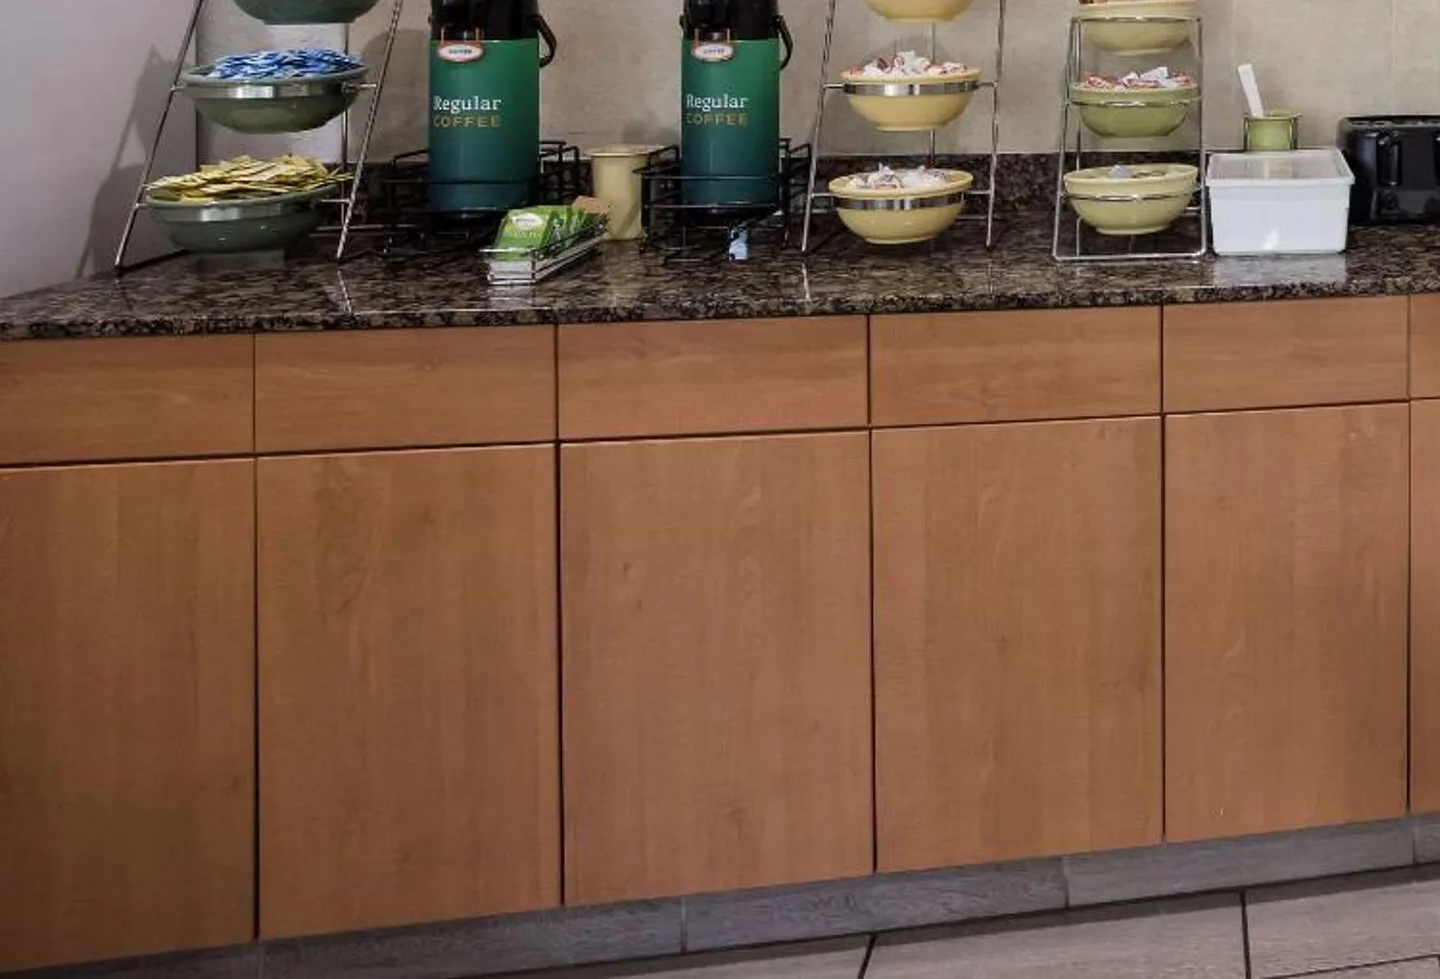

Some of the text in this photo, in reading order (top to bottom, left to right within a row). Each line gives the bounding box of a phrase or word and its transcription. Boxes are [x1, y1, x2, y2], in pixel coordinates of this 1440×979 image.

[433, 95, 502, 115] Regular
[686, 93, 749, 112] Regular
[432, 115, 502, 128] COFFEE
[684, 112, 748, 126] COFFEE
